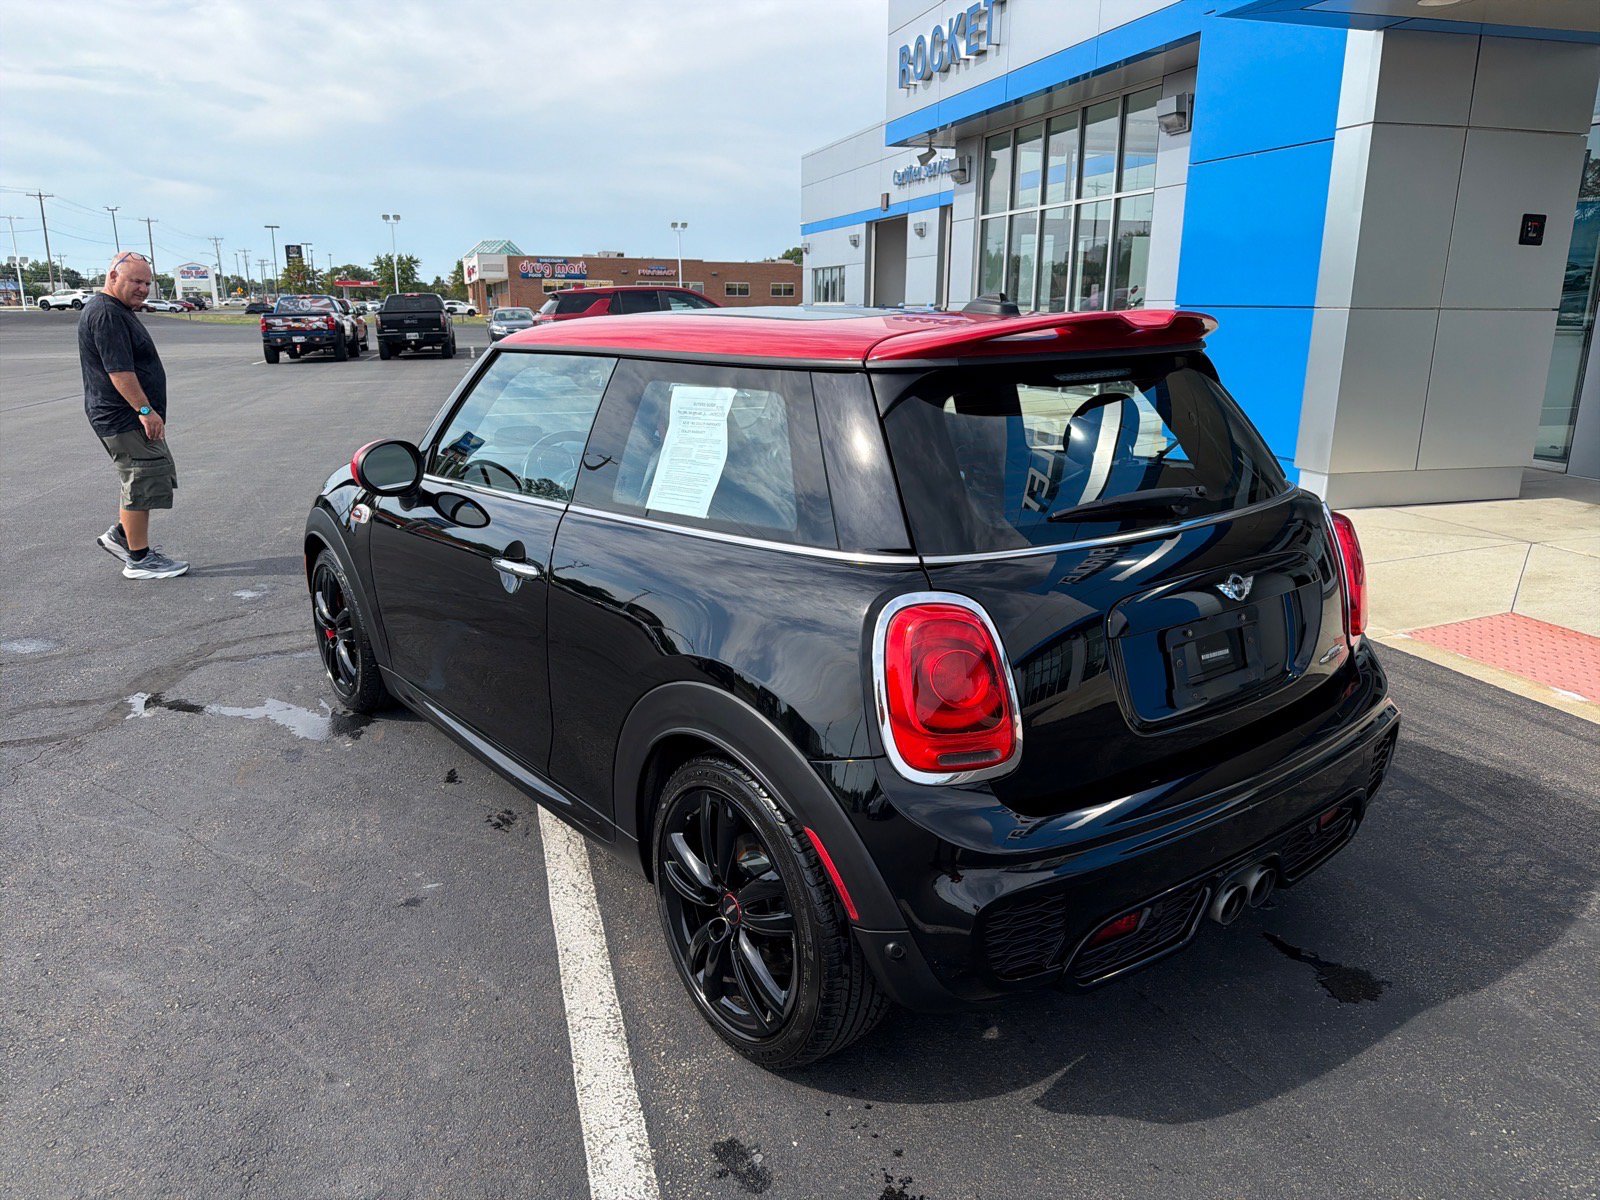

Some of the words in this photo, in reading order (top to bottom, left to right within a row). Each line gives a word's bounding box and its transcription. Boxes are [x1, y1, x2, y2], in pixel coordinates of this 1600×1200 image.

[898, 0, 1003, 89] ROCKET
[519, 260, 552, 278] drug
[555, 261, 587, 274] mart
[638, 268, 677, 276] PHARMACY
